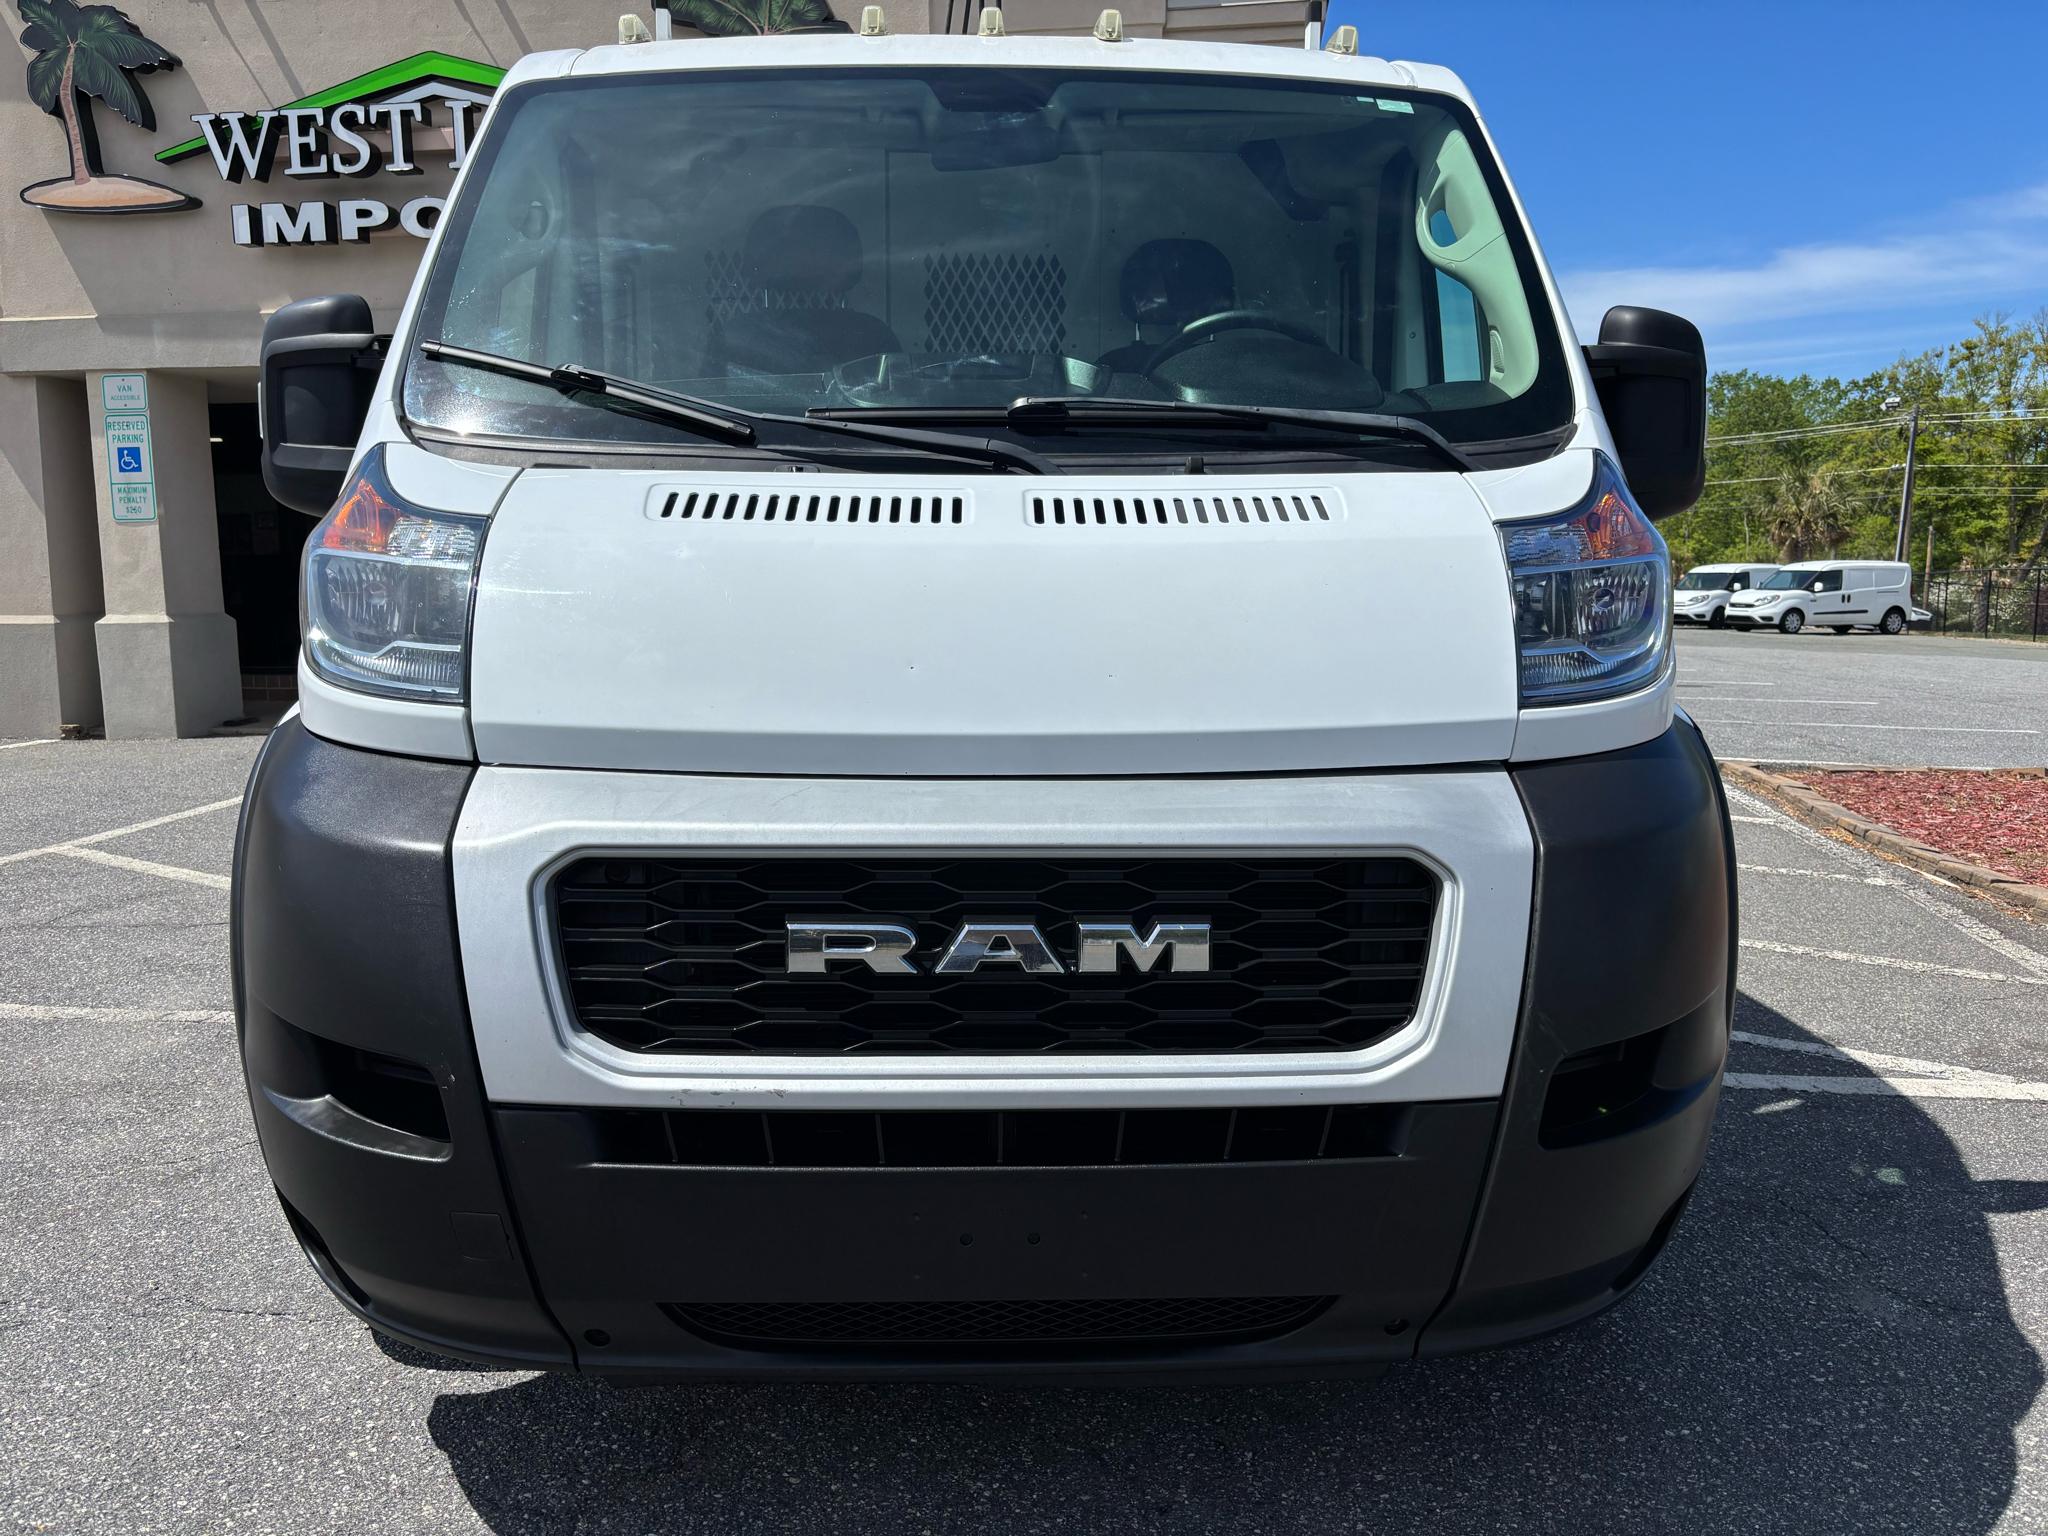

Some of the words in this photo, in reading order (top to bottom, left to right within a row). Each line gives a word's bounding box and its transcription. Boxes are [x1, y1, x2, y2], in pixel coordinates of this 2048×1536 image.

[191, 102, 424, 181] WEST
[232, 197, 448, 245] IMPO
[116, 384, 132, 393] VAN
[107, 421, 146, 431] RESERVED
[112, 434, 144, 443] PARKING
[119, 496, 146, 504] PENALTY
[785, 919, 1212, 974] RAM
